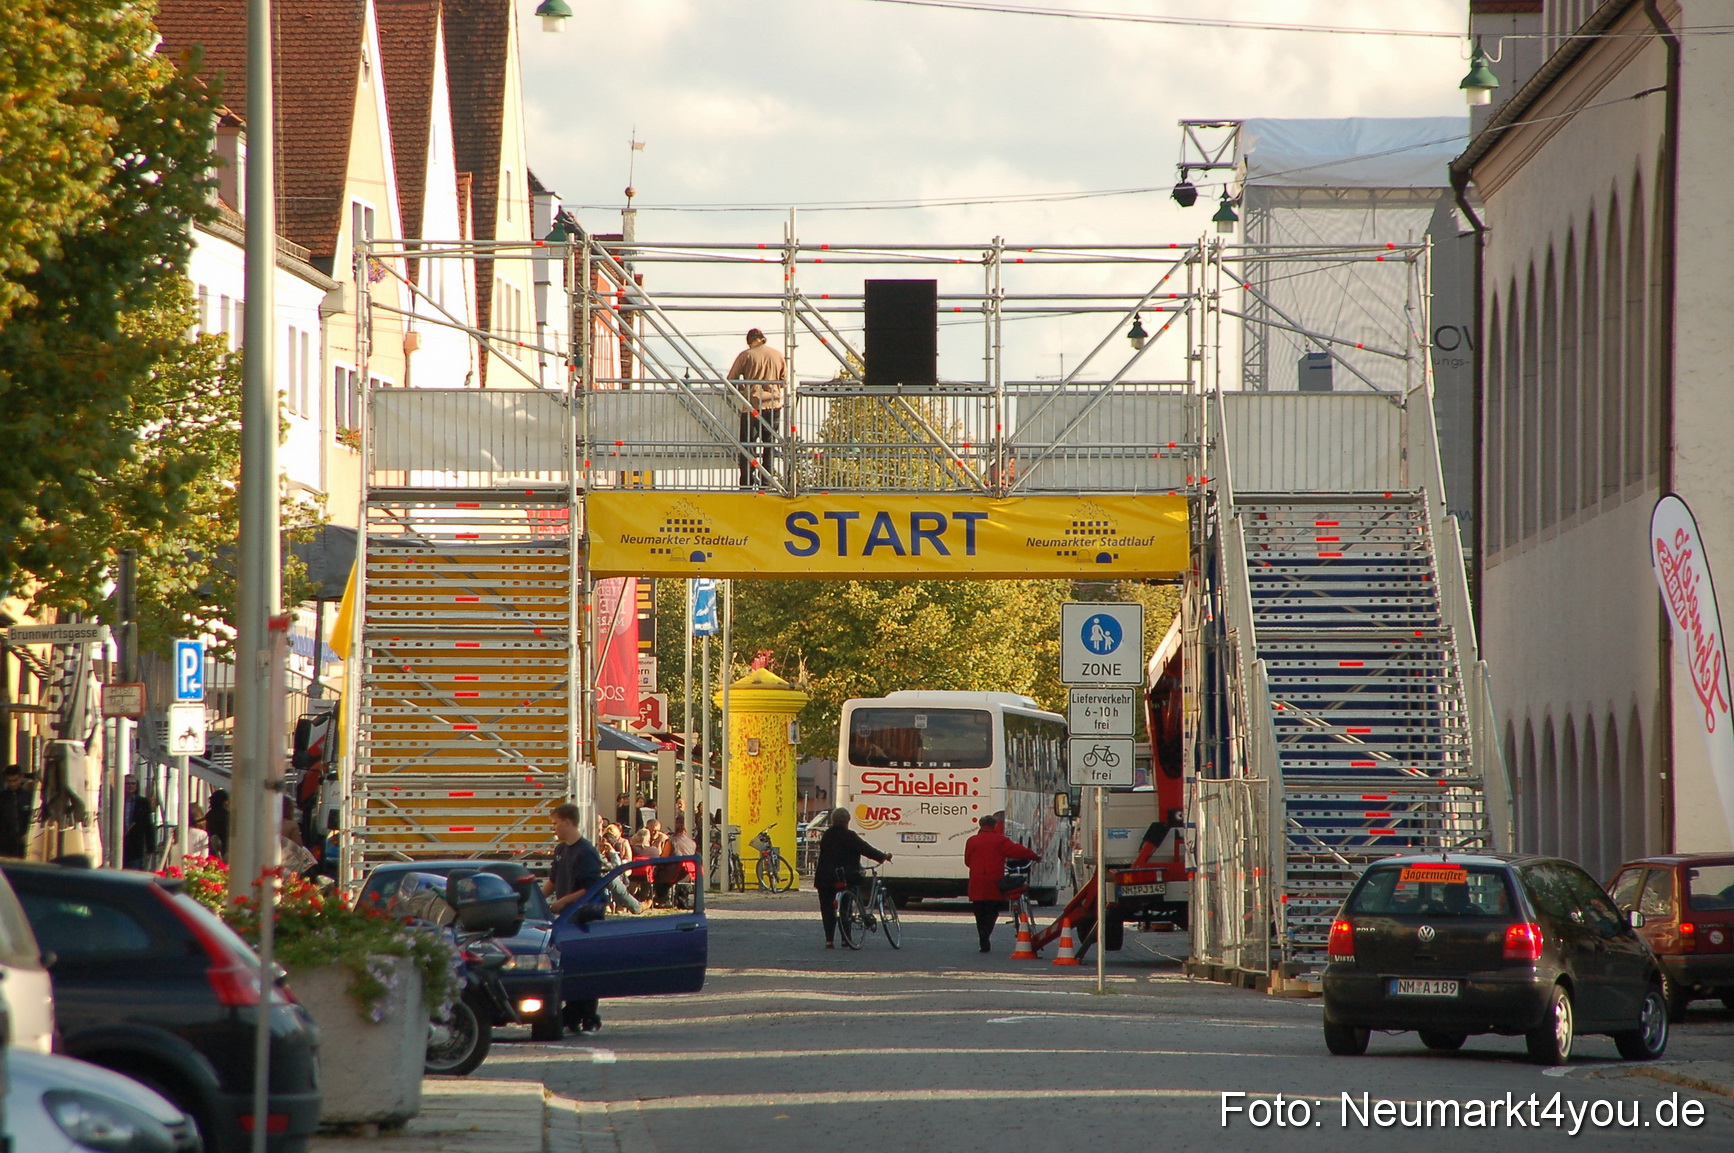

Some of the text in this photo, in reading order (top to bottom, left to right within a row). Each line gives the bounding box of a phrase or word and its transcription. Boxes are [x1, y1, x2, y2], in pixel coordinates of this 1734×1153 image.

[783, 510, 989, 557] START
[620, 534, 749, 546] Neumarkter Stadtlauf
[1026, 535, 1156, 548] Neumarkter Stadtlauf
[10, 626, 99, 641] Brunnwirtsgasse
[1082, 663, 1122, 676] ZONE
[1072, 693, 1131, 704] Lieferverkehr
[1113, 706, 1119, 717] h
[1094, 719, 1110, 730] frei
[1092, 770, 1112, 780] frei
[861, 771, 968, 796] Schielein
[865, 807, 902, 821] NRS
[920, 802, 968, 816] Reisen
[1150, 883, 1165, 893] 145
[1399, 982, 1457, 994] NM A 189
